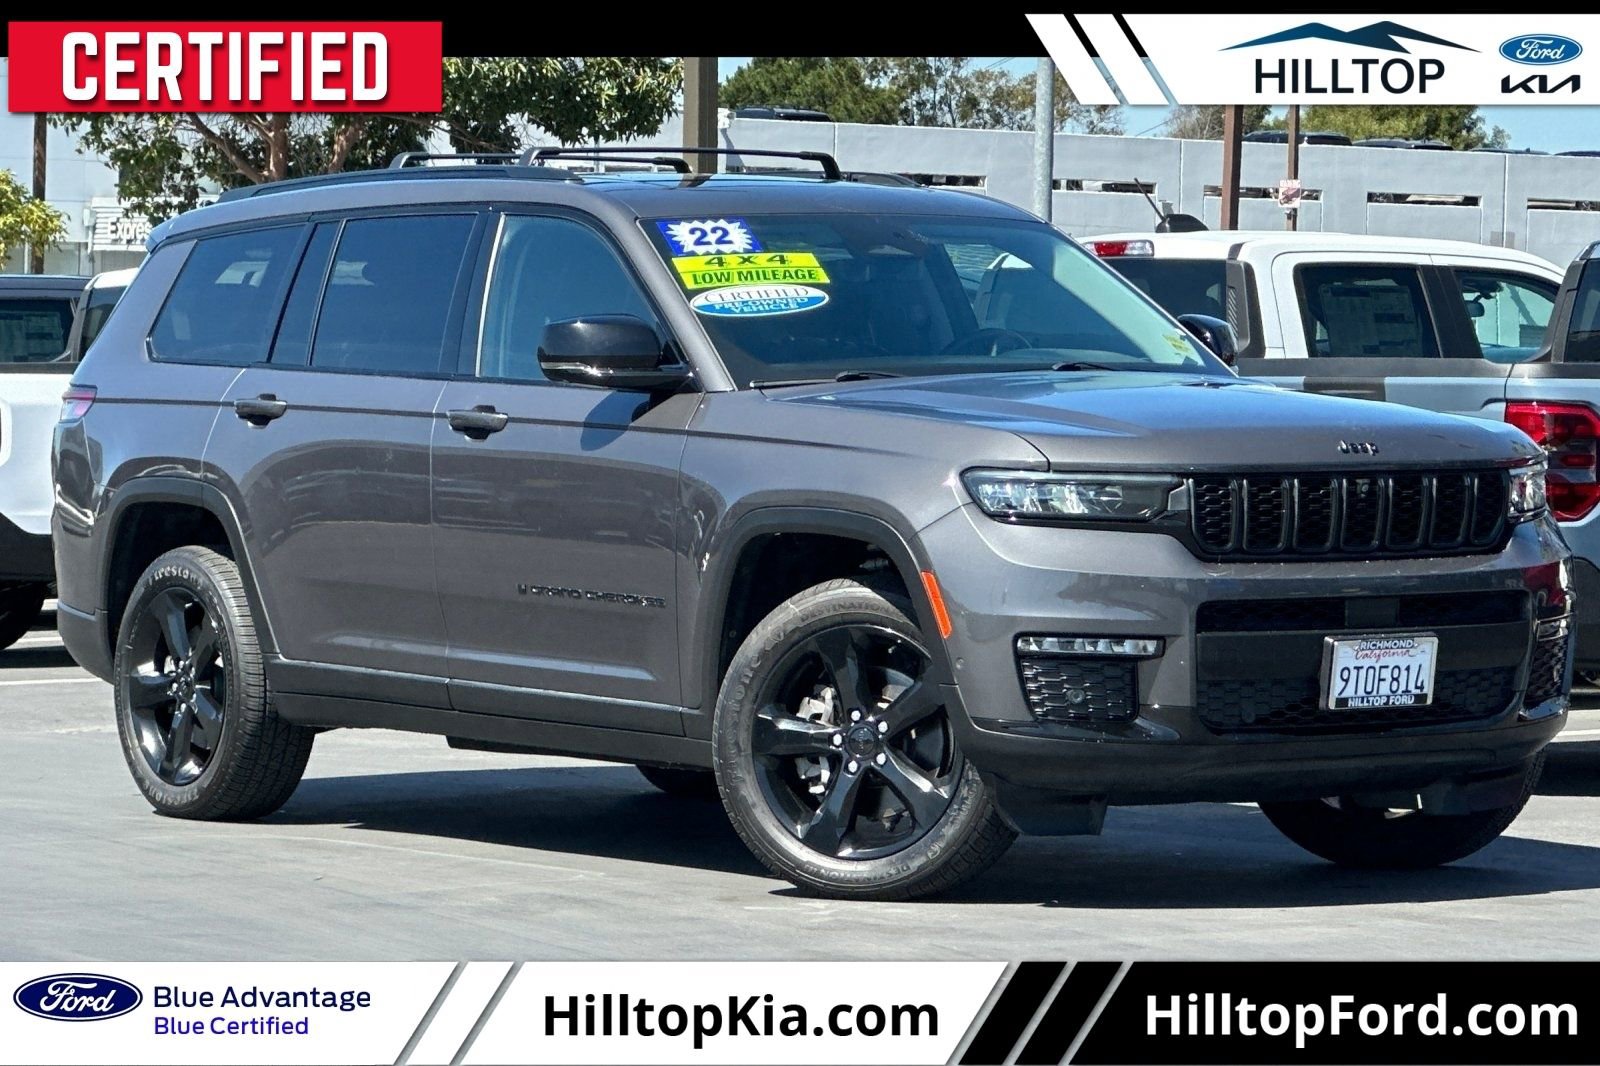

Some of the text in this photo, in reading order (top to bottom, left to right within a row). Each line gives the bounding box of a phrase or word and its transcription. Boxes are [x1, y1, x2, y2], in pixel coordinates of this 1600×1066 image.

[688, 226, 735, 247] 22
[692, 269, 817, 286] LOW MILEAGE
[704, 286, 810, 303] CERTIFIED
[714, 296, 809, 310] PRE-OWNED
[731, 303, 799, 314] VEHICLE
[1336, 440, 1380, 456] Jeep
[585, 590, 666, 608] CHEROKEE
[1360, 640, 1414, 650] RICHMOND
[1354, 649, 1417, 663] California
[1348, 694, 1415, 708] HILLTOP FORD
